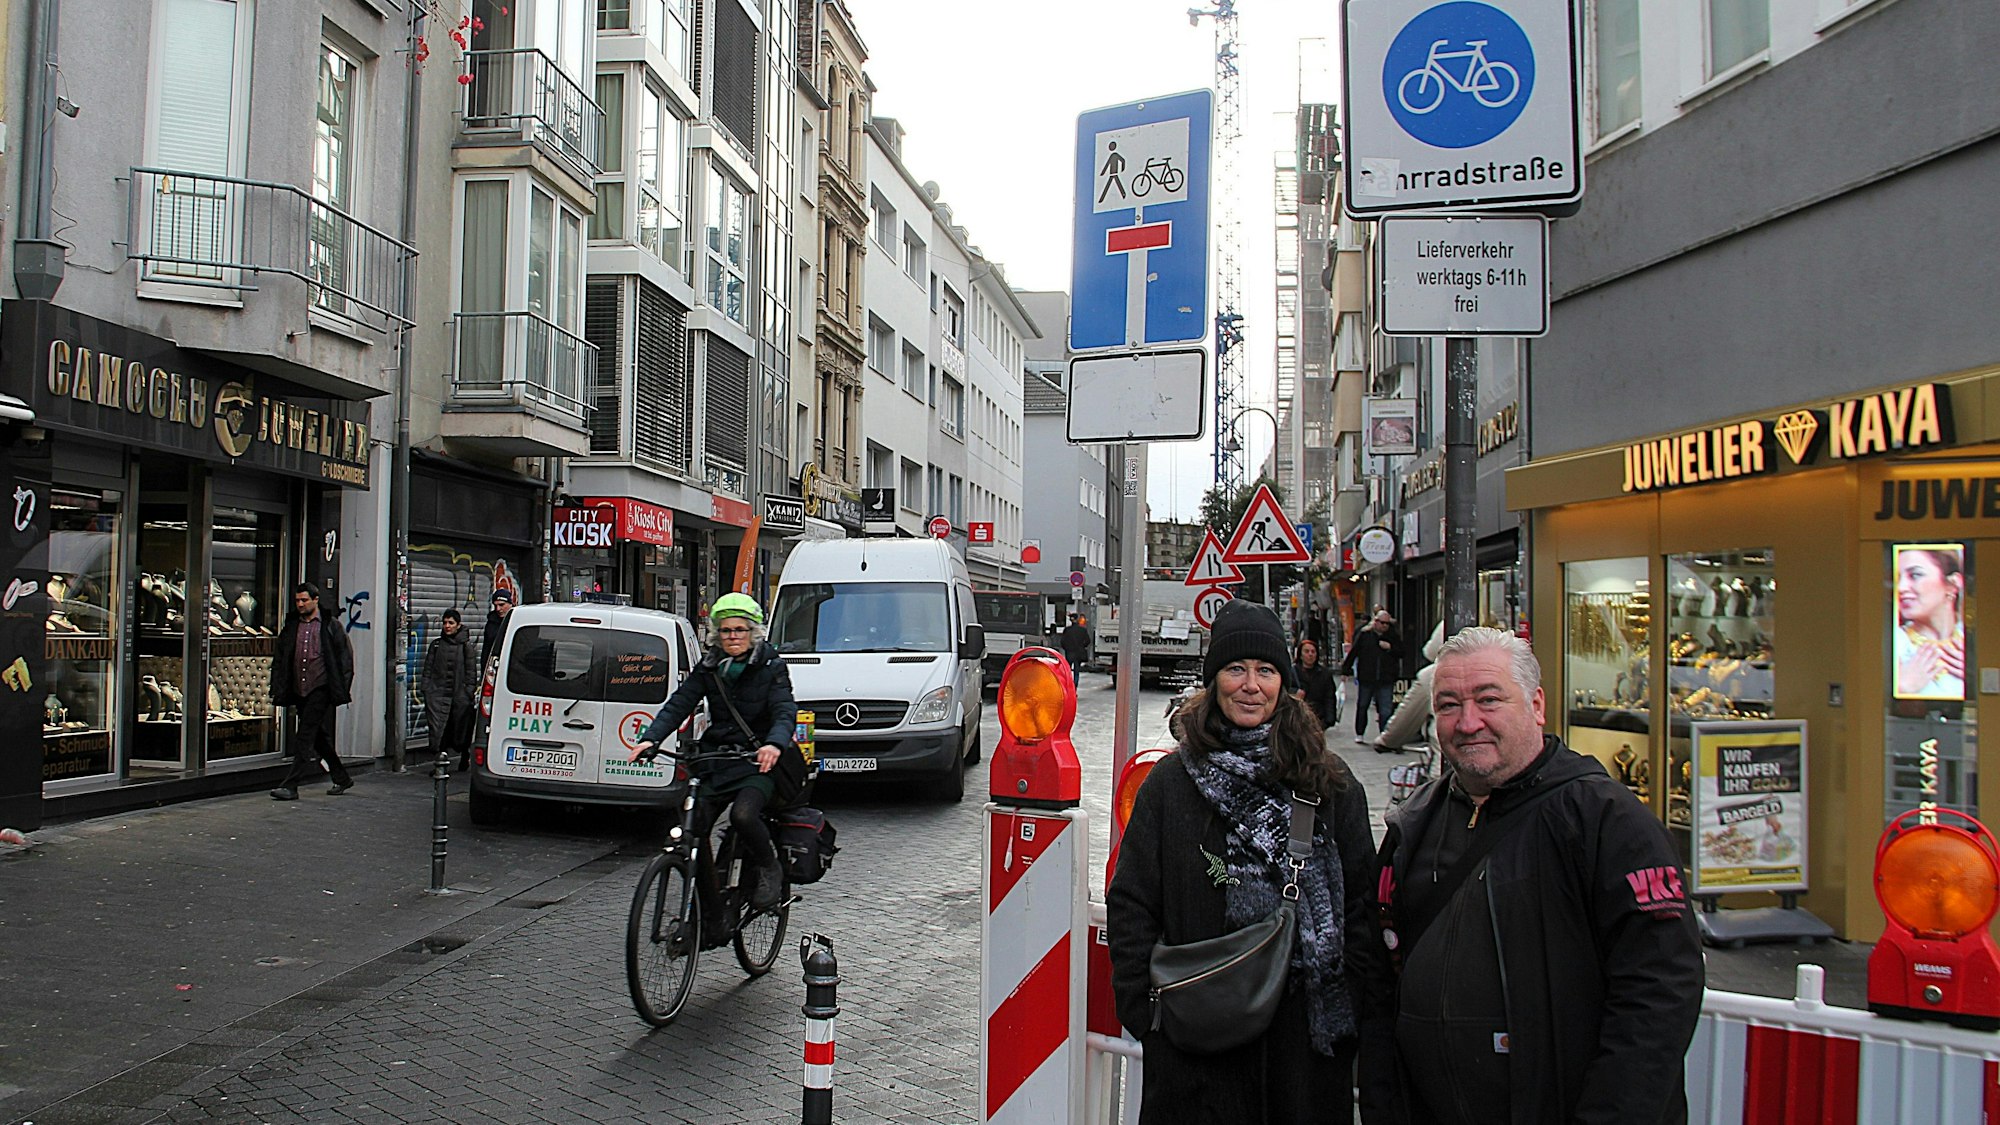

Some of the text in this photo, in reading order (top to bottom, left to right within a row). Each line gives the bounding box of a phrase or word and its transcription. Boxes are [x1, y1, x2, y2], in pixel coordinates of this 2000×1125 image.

[1417, 240, 1514, 258] Lieferverkehr
[1417, 267, 1482, 289] werktags
[1454, 295, 1478, 312] frei
[258, 397, 368, 465] JUWELIER
[1622, 383, 1941, 492] JUWELIER KAYA
[570, 510, 598, 522] CITY
[634, 505, 656, 530] Kiosk
[657, 511, 672, 539] City
[554, 522, 612, 546] KIOSK
[45, 639, 113, 660] DANKAU
[513, 700, 553, 716] FAIR
[508, 717, 553, 733] PLAY
[514, 749, 574, 766] L FP 2001
[605, 759, 655, 769] SPORSBAR
[824, 758, 876, 770] K DA 2726
[1723, 749, 1751, 762] WIR
[42, 757, 92, 779] eparatur
[605, 767, 664, 778] CASINOGAMES
[1723, 762, 1781, 778] KAUFEN
[1919, 738, 1938, 795] KAYA
[1723, 777, 1791, 792] IHR GOLD
[1721, 802, 1781, 823] BARGELD
